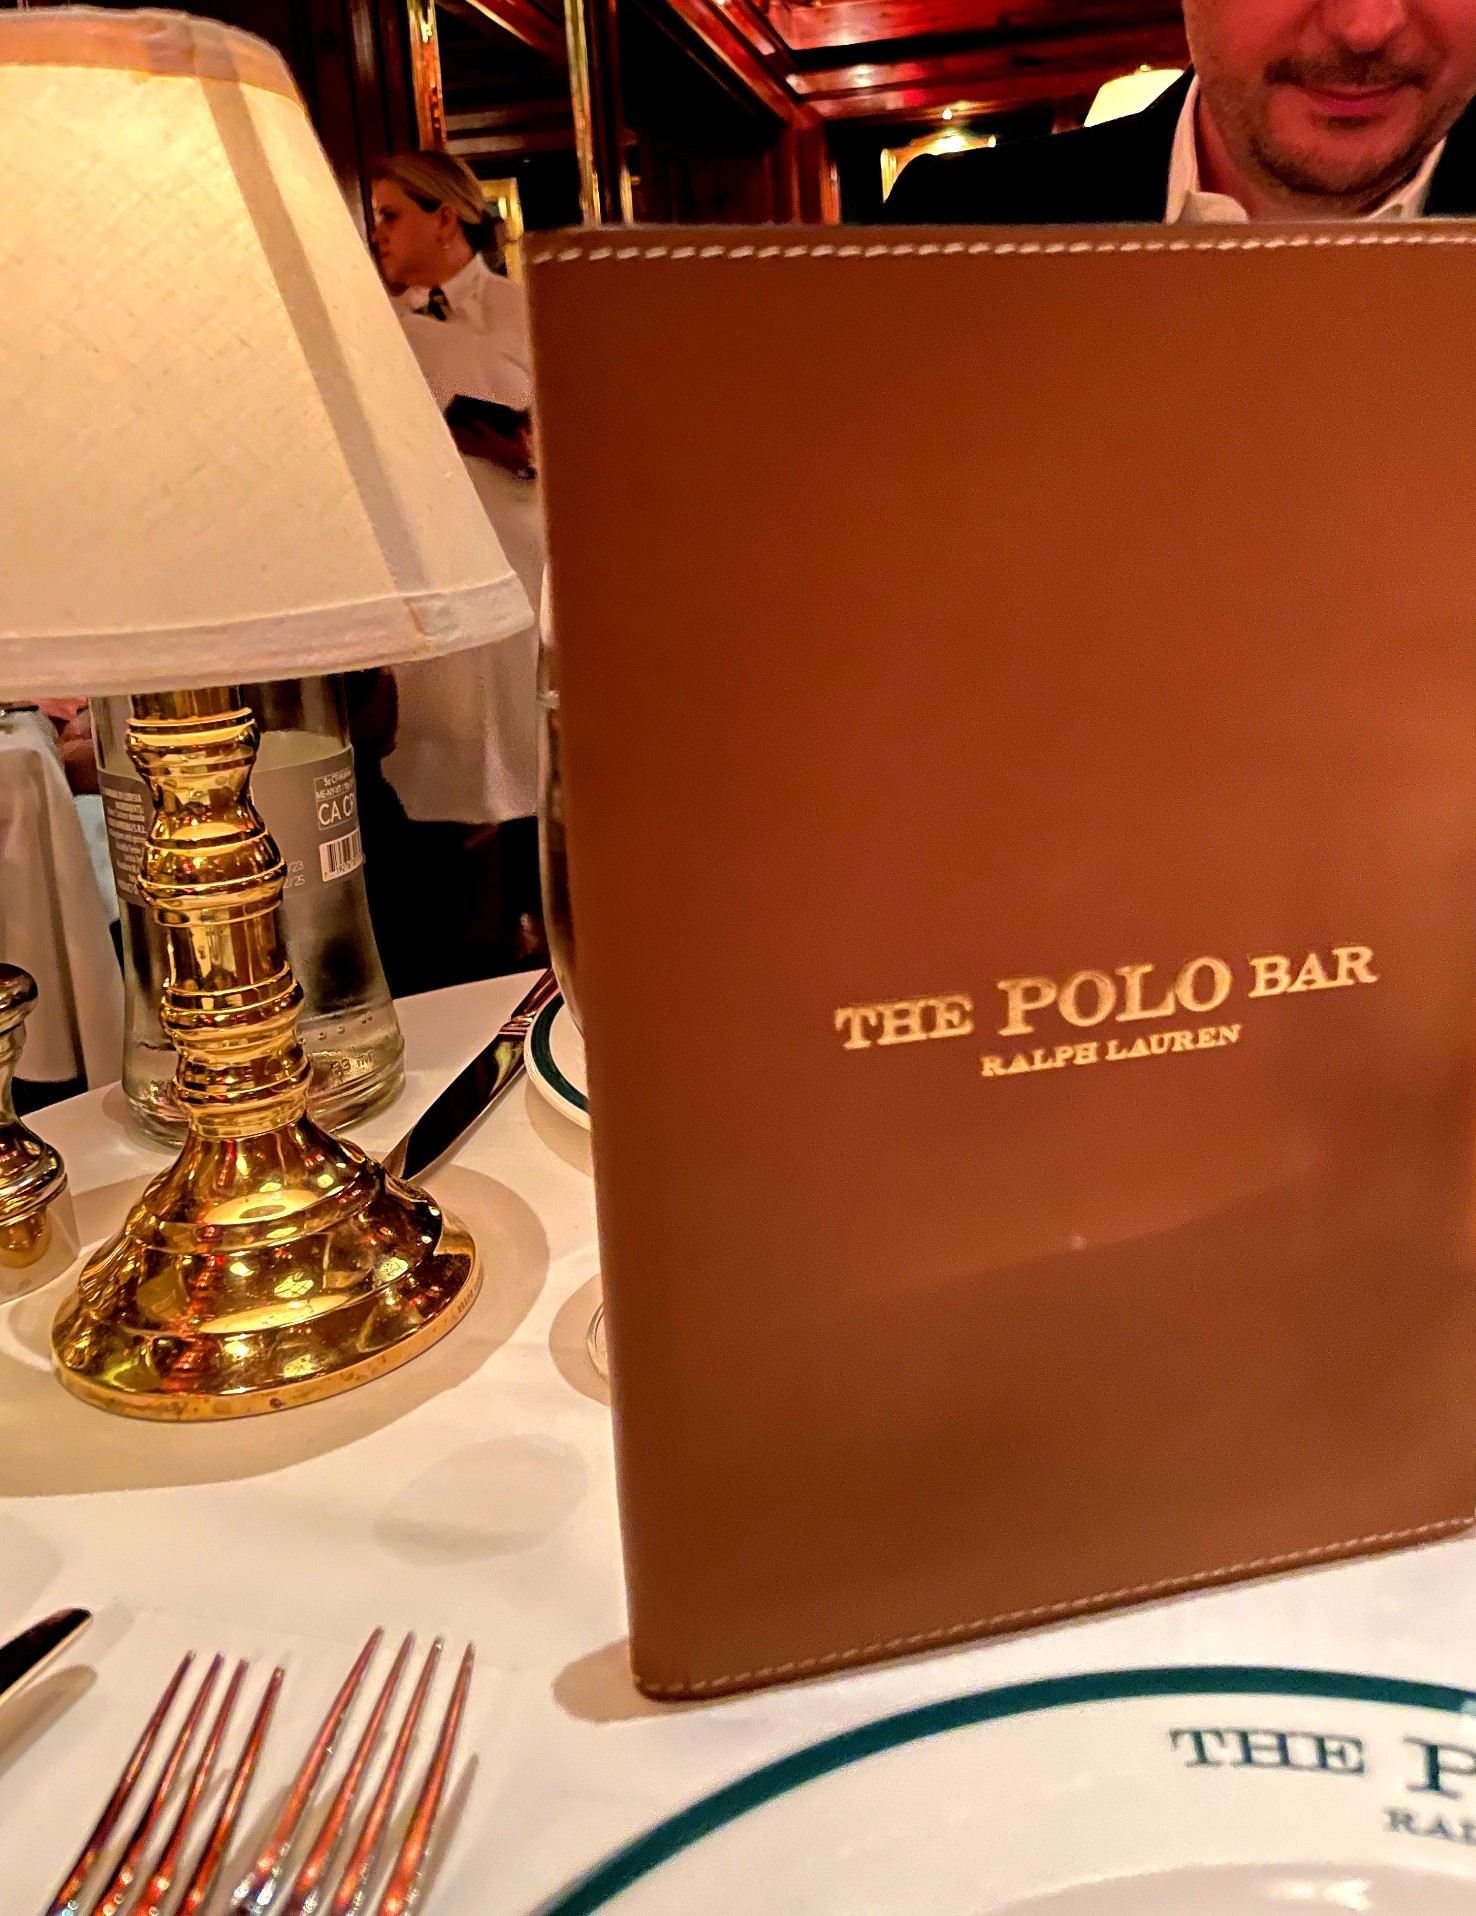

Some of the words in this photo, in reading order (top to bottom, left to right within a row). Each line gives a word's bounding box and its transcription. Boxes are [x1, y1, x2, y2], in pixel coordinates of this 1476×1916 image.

[318, 800, 342, 826] CA
[834, 992, 974, 1051] THE
[998, 955, 1234, 1037] POLO
[1248, 946, 1378, 998] BAR
[981, 1041, 1098, 1078] RALPH
[1105, 1023, 1243, 1061] LAUREN
[1170, 1727, 1366, 1776] THE
